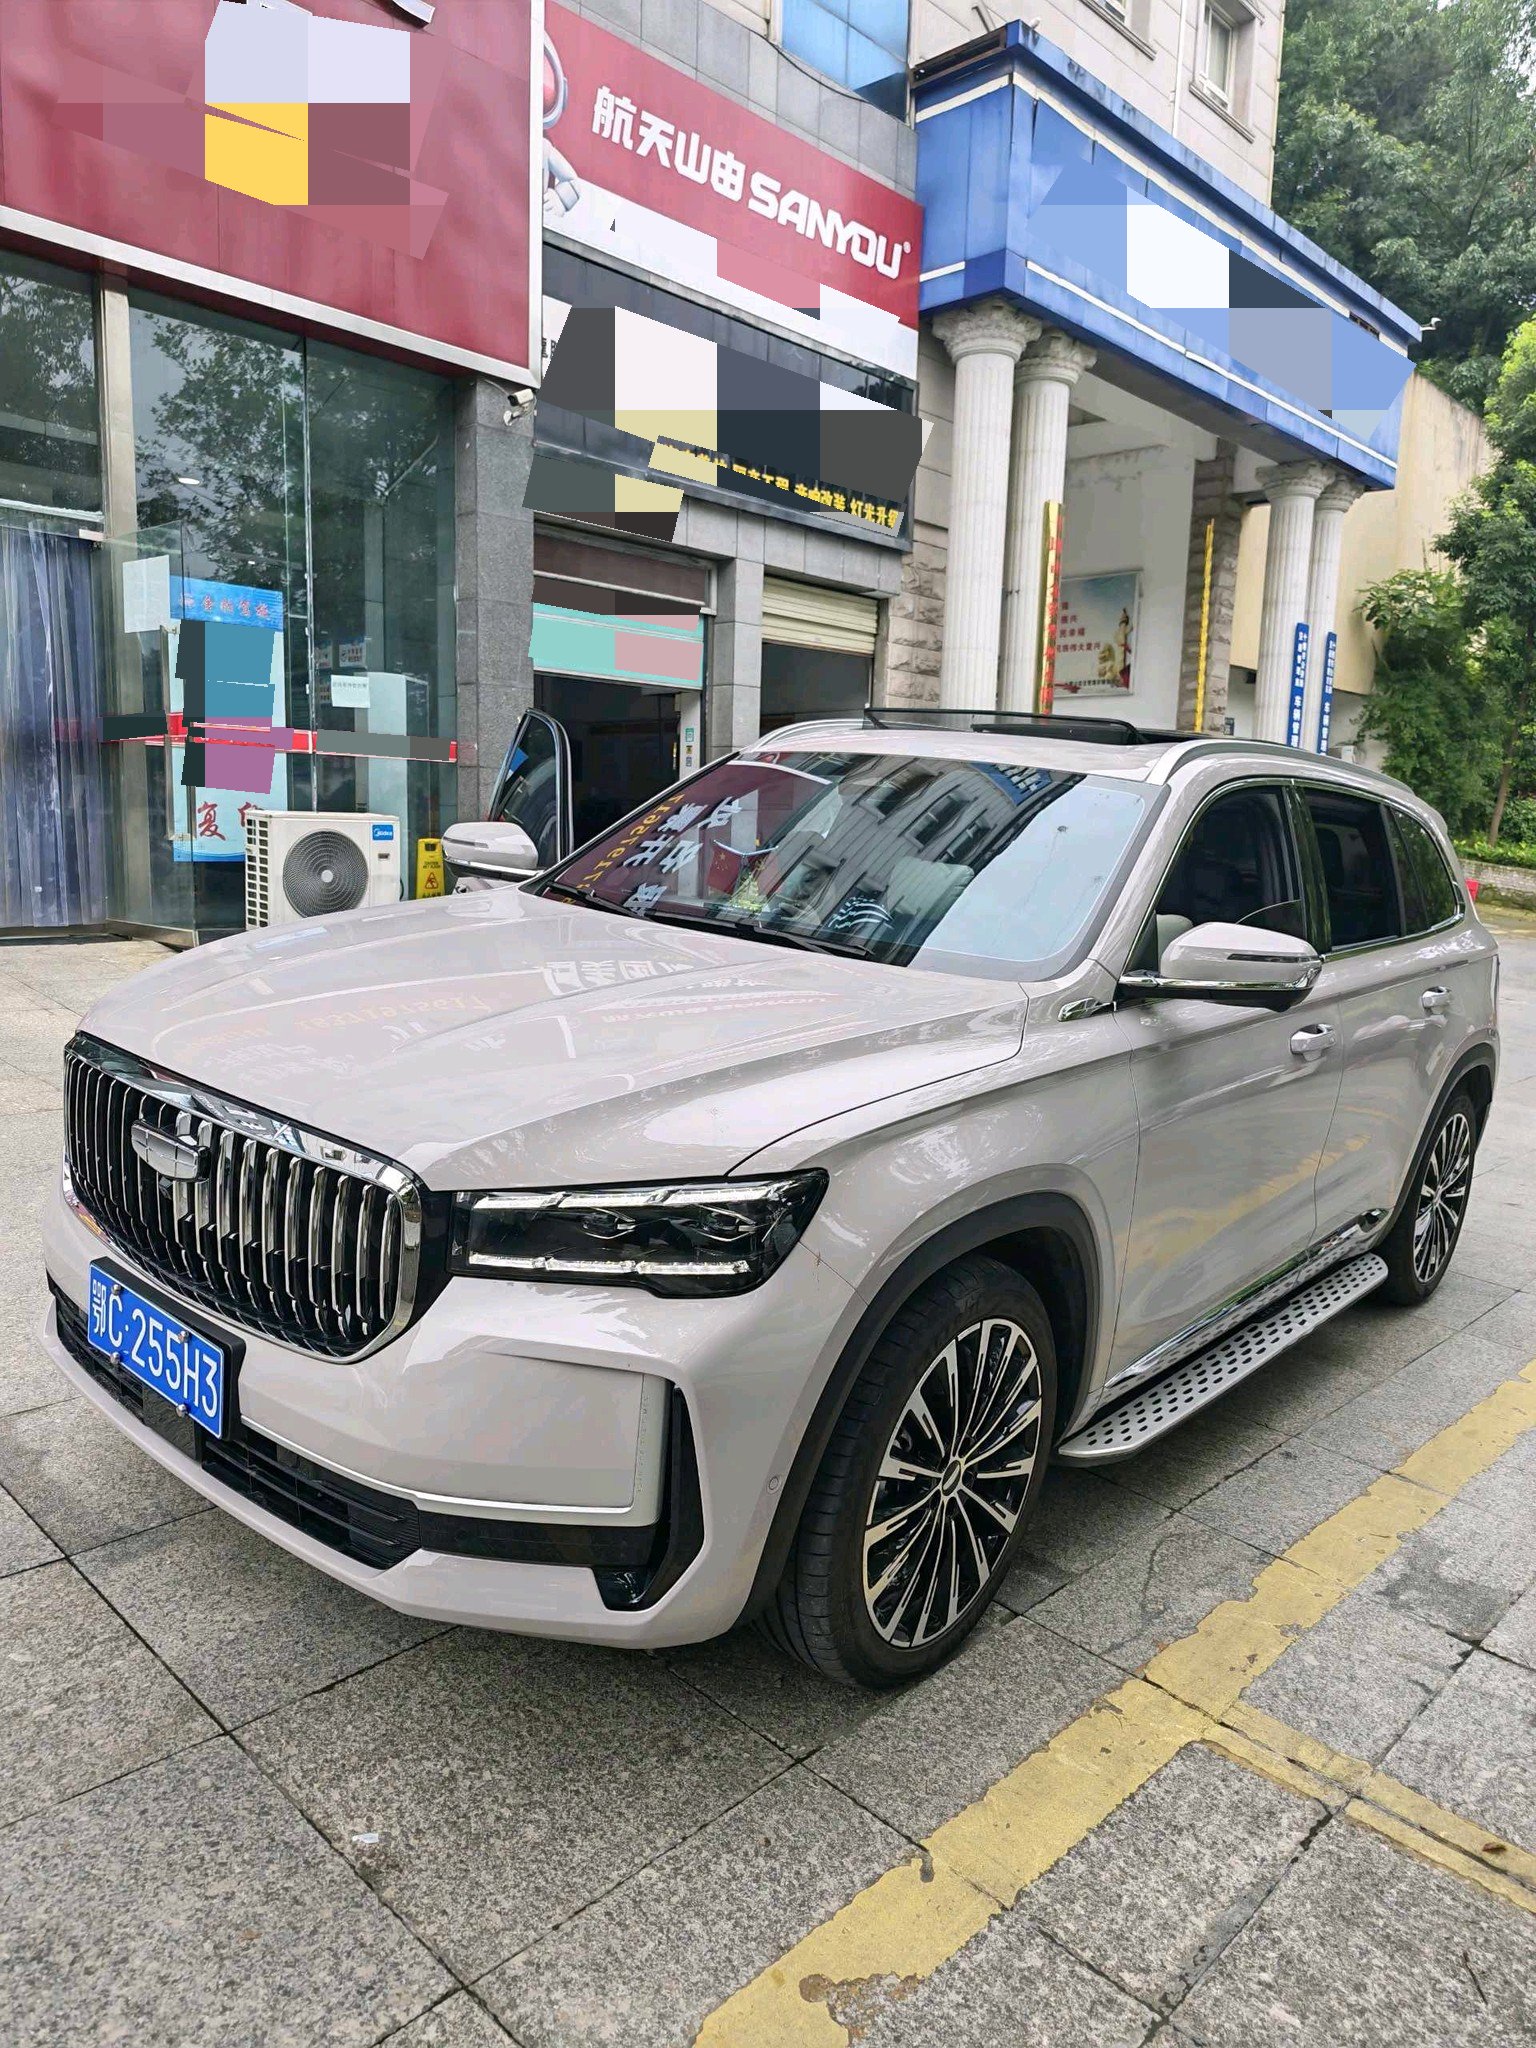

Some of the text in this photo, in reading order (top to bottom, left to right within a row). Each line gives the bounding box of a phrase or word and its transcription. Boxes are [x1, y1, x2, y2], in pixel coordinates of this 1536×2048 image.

[591, 85, 902, 280] 航天山由 SANYOU
